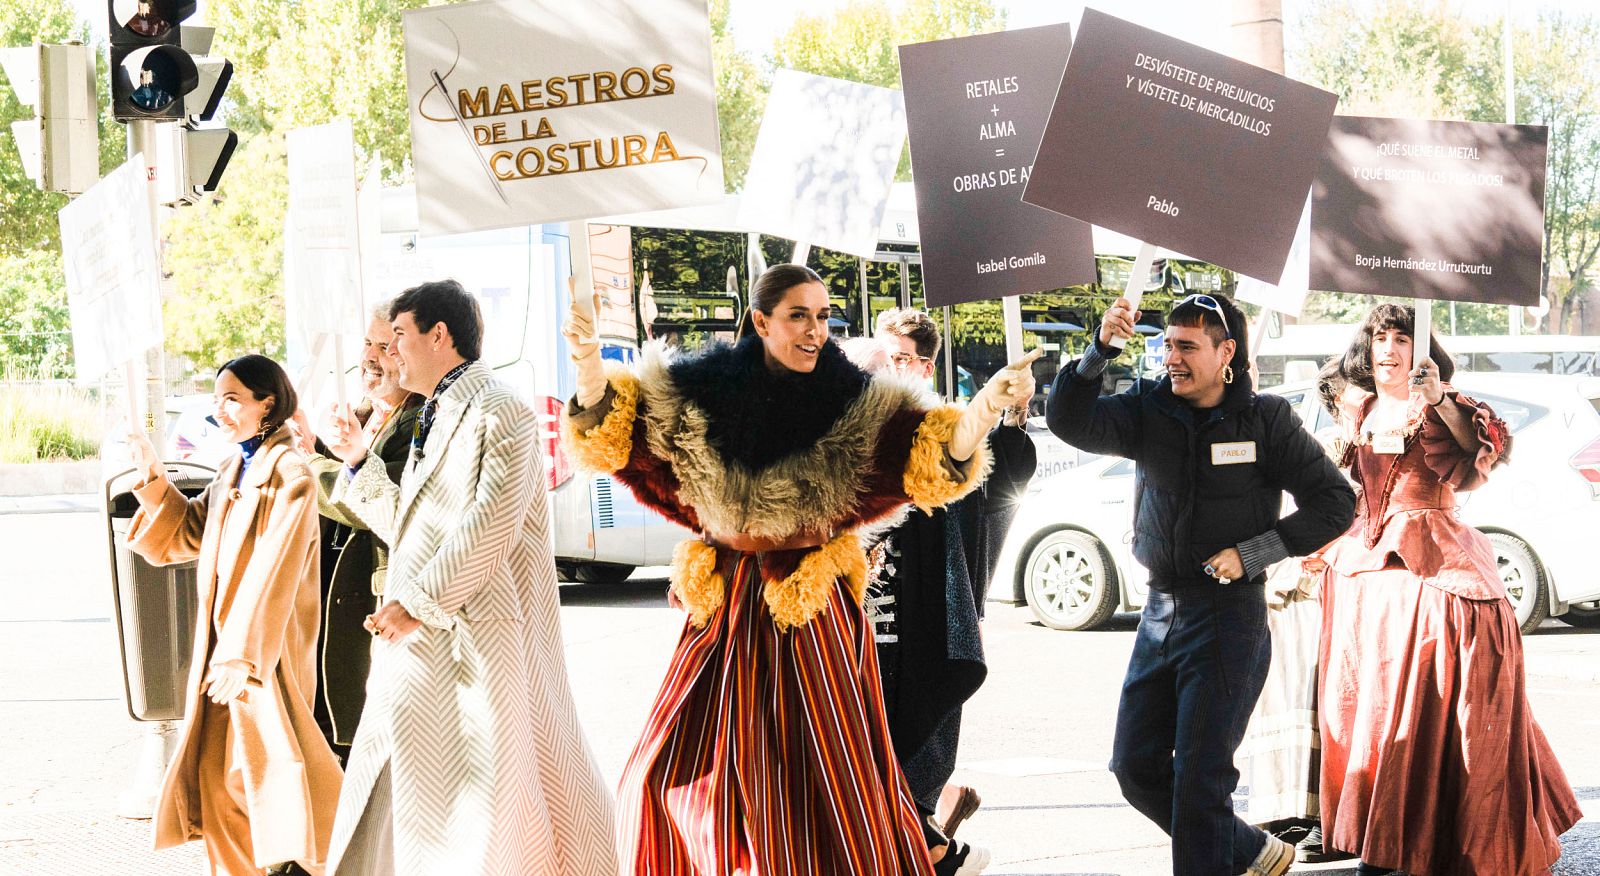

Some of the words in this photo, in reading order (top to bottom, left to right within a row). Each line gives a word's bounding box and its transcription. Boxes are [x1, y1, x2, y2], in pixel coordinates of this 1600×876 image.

[458, 63, 676, 119] MAESTROS
[966, 76, 1019, 99] RETALES
[1134, 53, 1198, 86] DESVÍSTETE
[1197, 75, 1214, 92] DE
[1214, 80, 1276, 113] PREJUICIOS
[1125, 74, 1135, 89] Y
[1137, 78, 1180, 105] VÍSTETE
[1179, 93, 1197, 111] DE
[1196, 100, 1272, 137] MERCADILLOS
[473, 121, 507, 146] DE
[521, 116, 557, 140] LA
[979, 120, 1017, 141] ALMA
[490, 131, 680, 181] COSTURA
[1401, 144, 1433, 158] SUENE
[1434, 145, 1447, 158] EL
[1447, 146, 1480, 161] METAL
[953, 171, 997, 192] OBRAS
[999, 168, 1018, 186] DE
[1352, 166, 1361, 179] Y
[1361, 165, 1383, 181] QUÉ
[1384, 167, 1425, 182] BROTEN
[1426, 169, 1448, 184] LOS
[1146, 195, 1180, 217] Pablo
[976, 257, 1008, 274] Isabel
[1009, 252, 1046, 268] Gomila
[1355, 254, 1381, 270] Borja
[1382, 256, 1437, 272] Hernández
[1438, 259, 1492, 275] Urrutxurtu
[1220, 449, 1247, 458] PABLO
